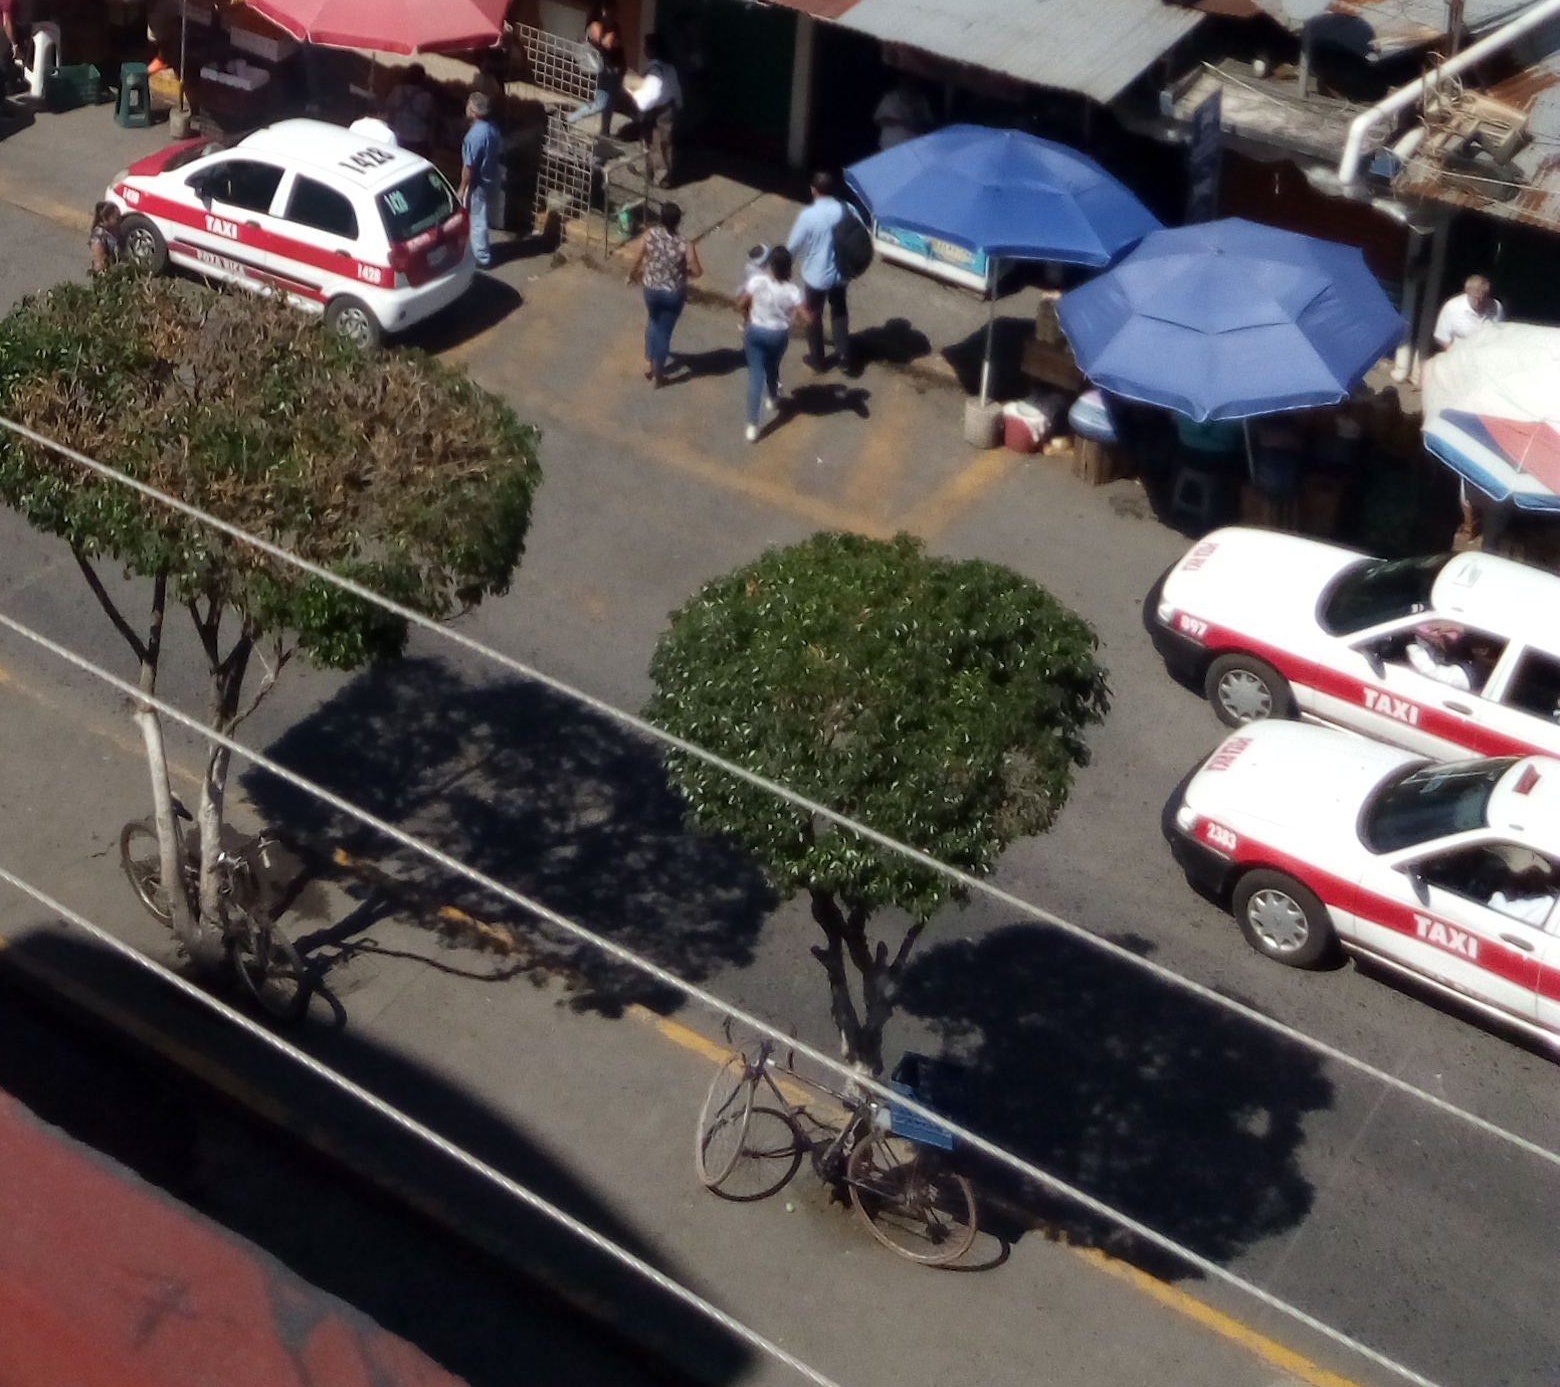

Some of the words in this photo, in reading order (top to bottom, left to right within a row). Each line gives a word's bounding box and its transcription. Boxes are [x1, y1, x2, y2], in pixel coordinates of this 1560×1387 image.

[339, 146, 395, 175] 1428
[205, 214, 238, 240] TAXI
[357, 262, 382, 285] 1428
[1180, 613, 1208, 636] 897
[1363, 687, 1419, 725] TAXI
[1206, 822, 1237, 850] 2383
[1413, 914, 1478, 959] TAXI
